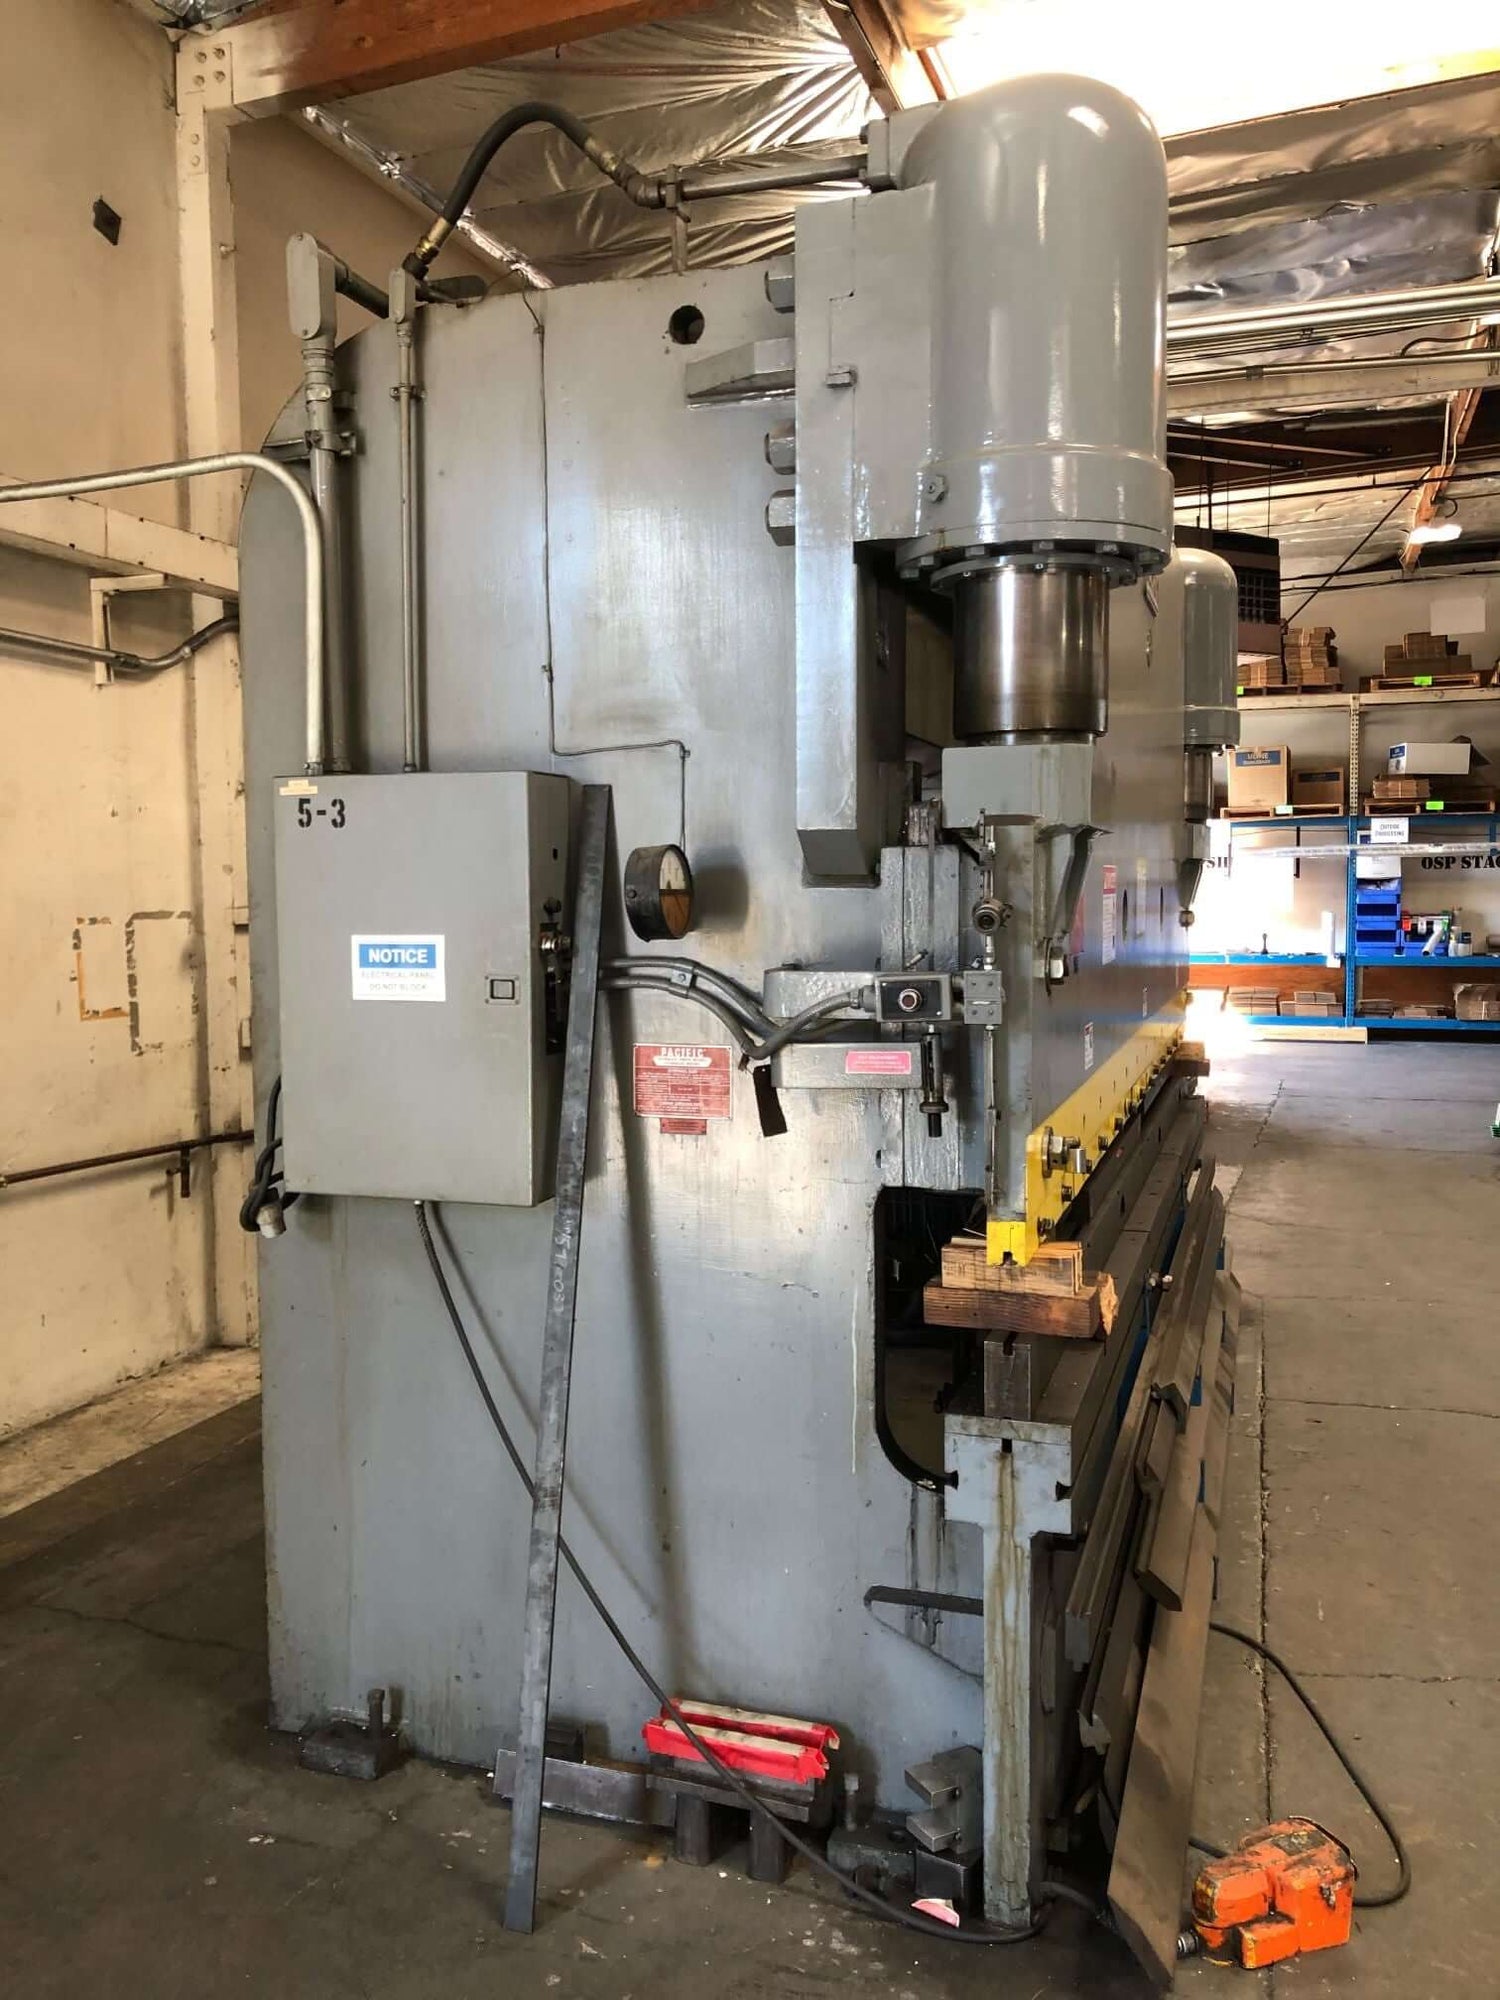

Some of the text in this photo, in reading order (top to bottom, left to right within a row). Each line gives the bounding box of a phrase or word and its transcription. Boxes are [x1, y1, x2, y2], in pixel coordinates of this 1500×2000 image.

[297, 797, 346, 829] 5-3
[1421, 855, 1456, 870] OSP
[368, 947, 428, 964] NOTICE
[661, 1047, 704, 1058] PACIFIC
